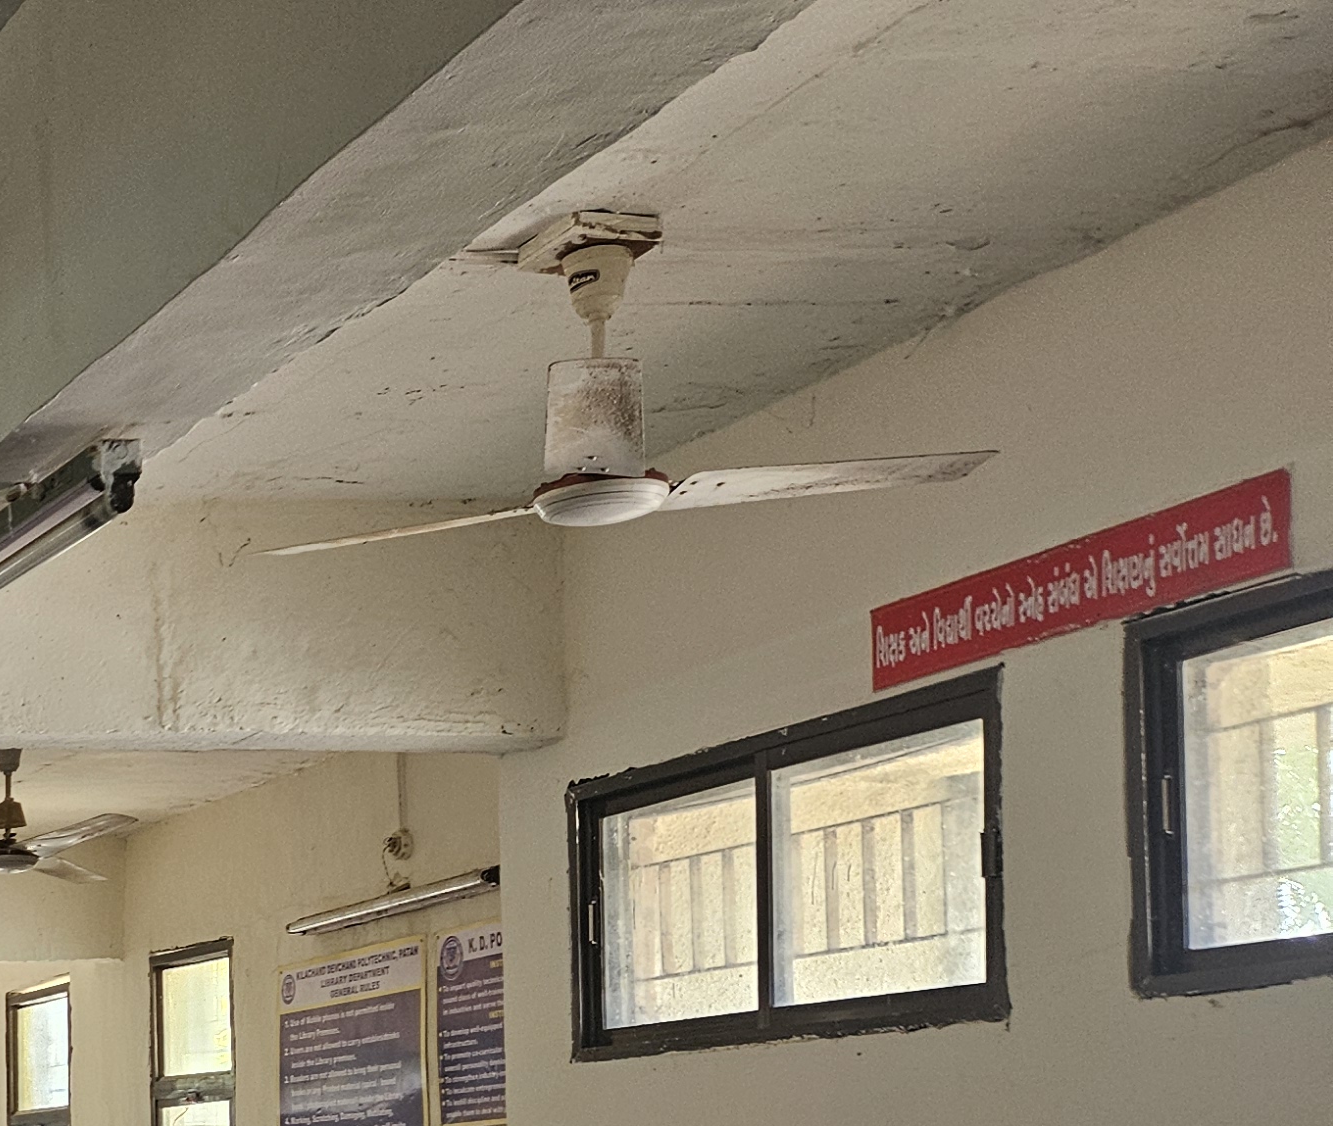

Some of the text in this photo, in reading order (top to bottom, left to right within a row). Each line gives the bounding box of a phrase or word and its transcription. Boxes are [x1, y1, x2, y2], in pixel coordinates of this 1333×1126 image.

[908, 611, 931, 656] અને
[320, 966, 389, 988] LIBRARY DEPARTMENT
